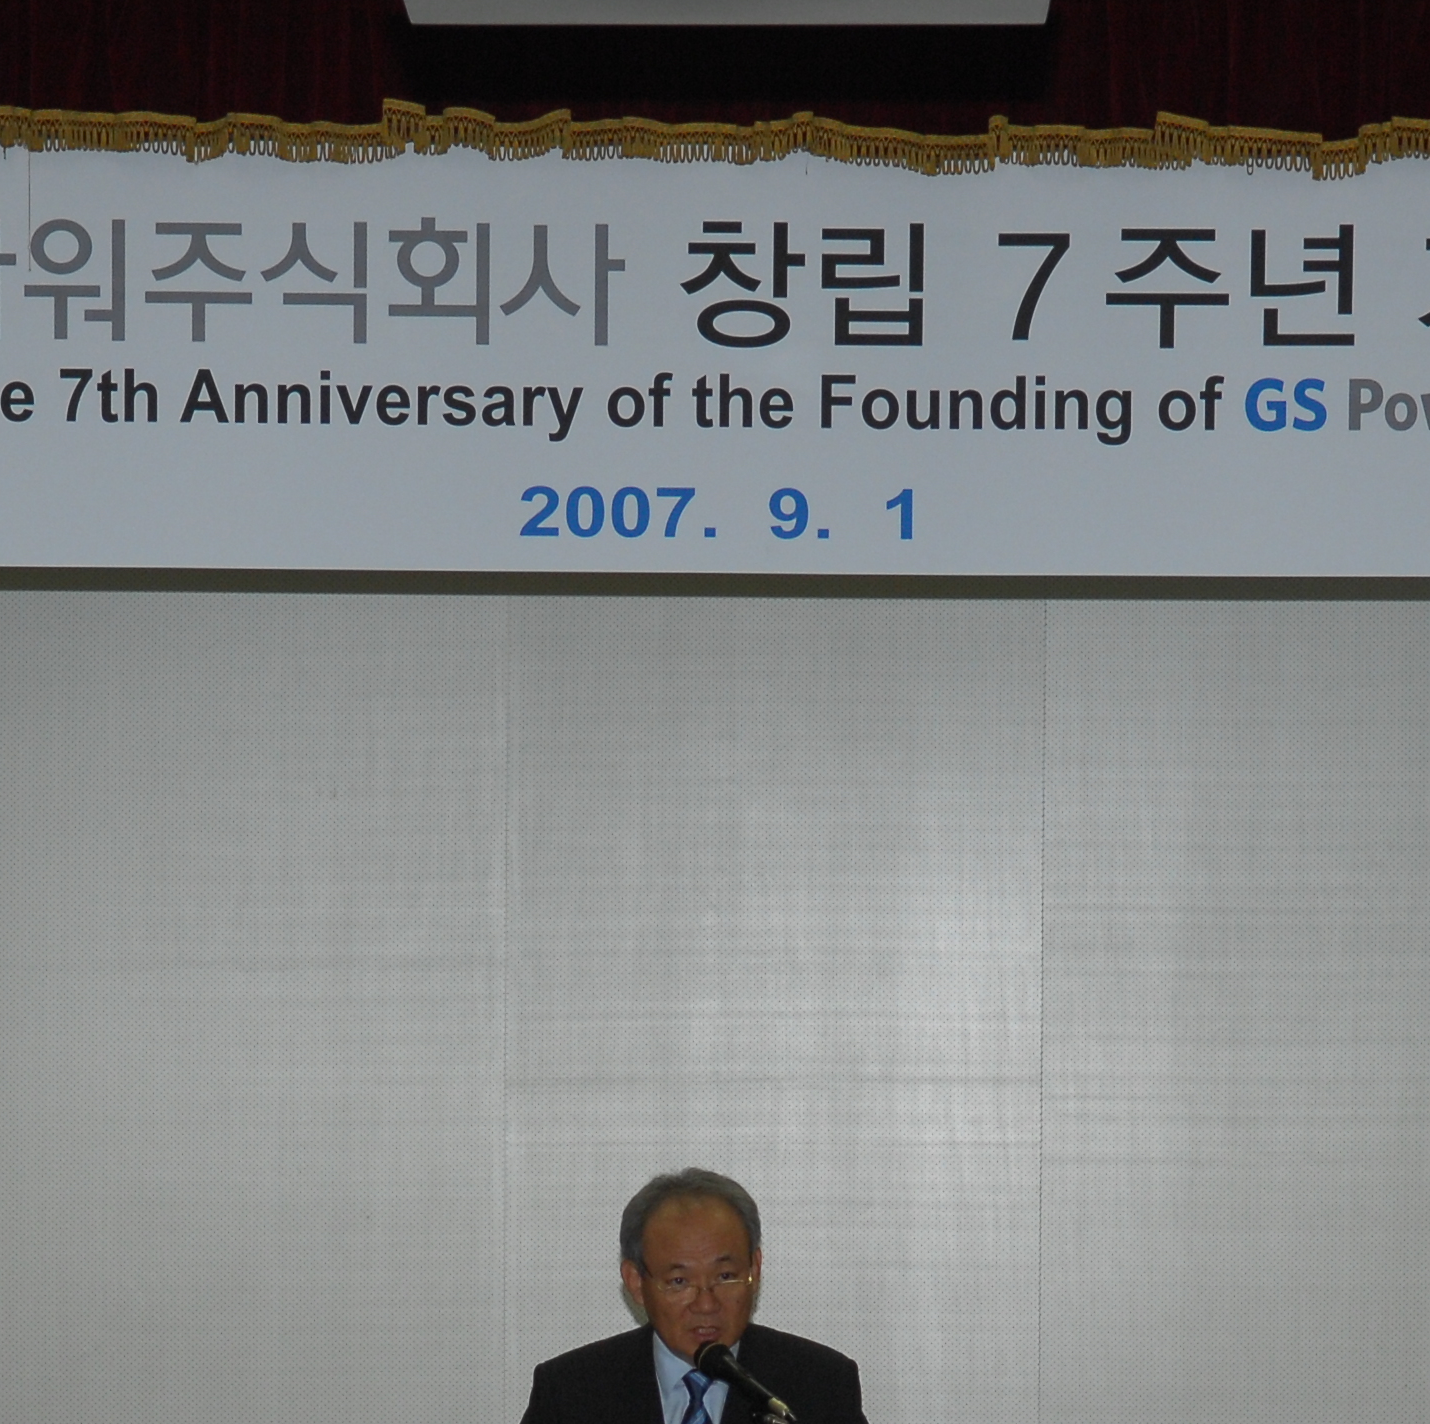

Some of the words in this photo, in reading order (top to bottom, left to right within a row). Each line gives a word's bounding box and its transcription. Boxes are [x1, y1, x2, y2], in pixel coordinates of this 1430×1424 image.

[680, 220, 925, 349] 창립
[997, 232, 1071, 341] 7
[1105, 223, 1355, 350] 주년
[59, 368, 158, 424] 7th
[180, 368, 584, 443] Anniversary
[607, 372, 673, 428] of
[691, 373, 794, 430] the
[820, 374, 1132, 446] Founding
[1158, 375, 1225, 432] of
[1244, 377, 1328, 433] GS
[519, 485, 717, 539] 2007.
[768, 487, 830, 540] 9.
[886, 488, 915, 541] 1
